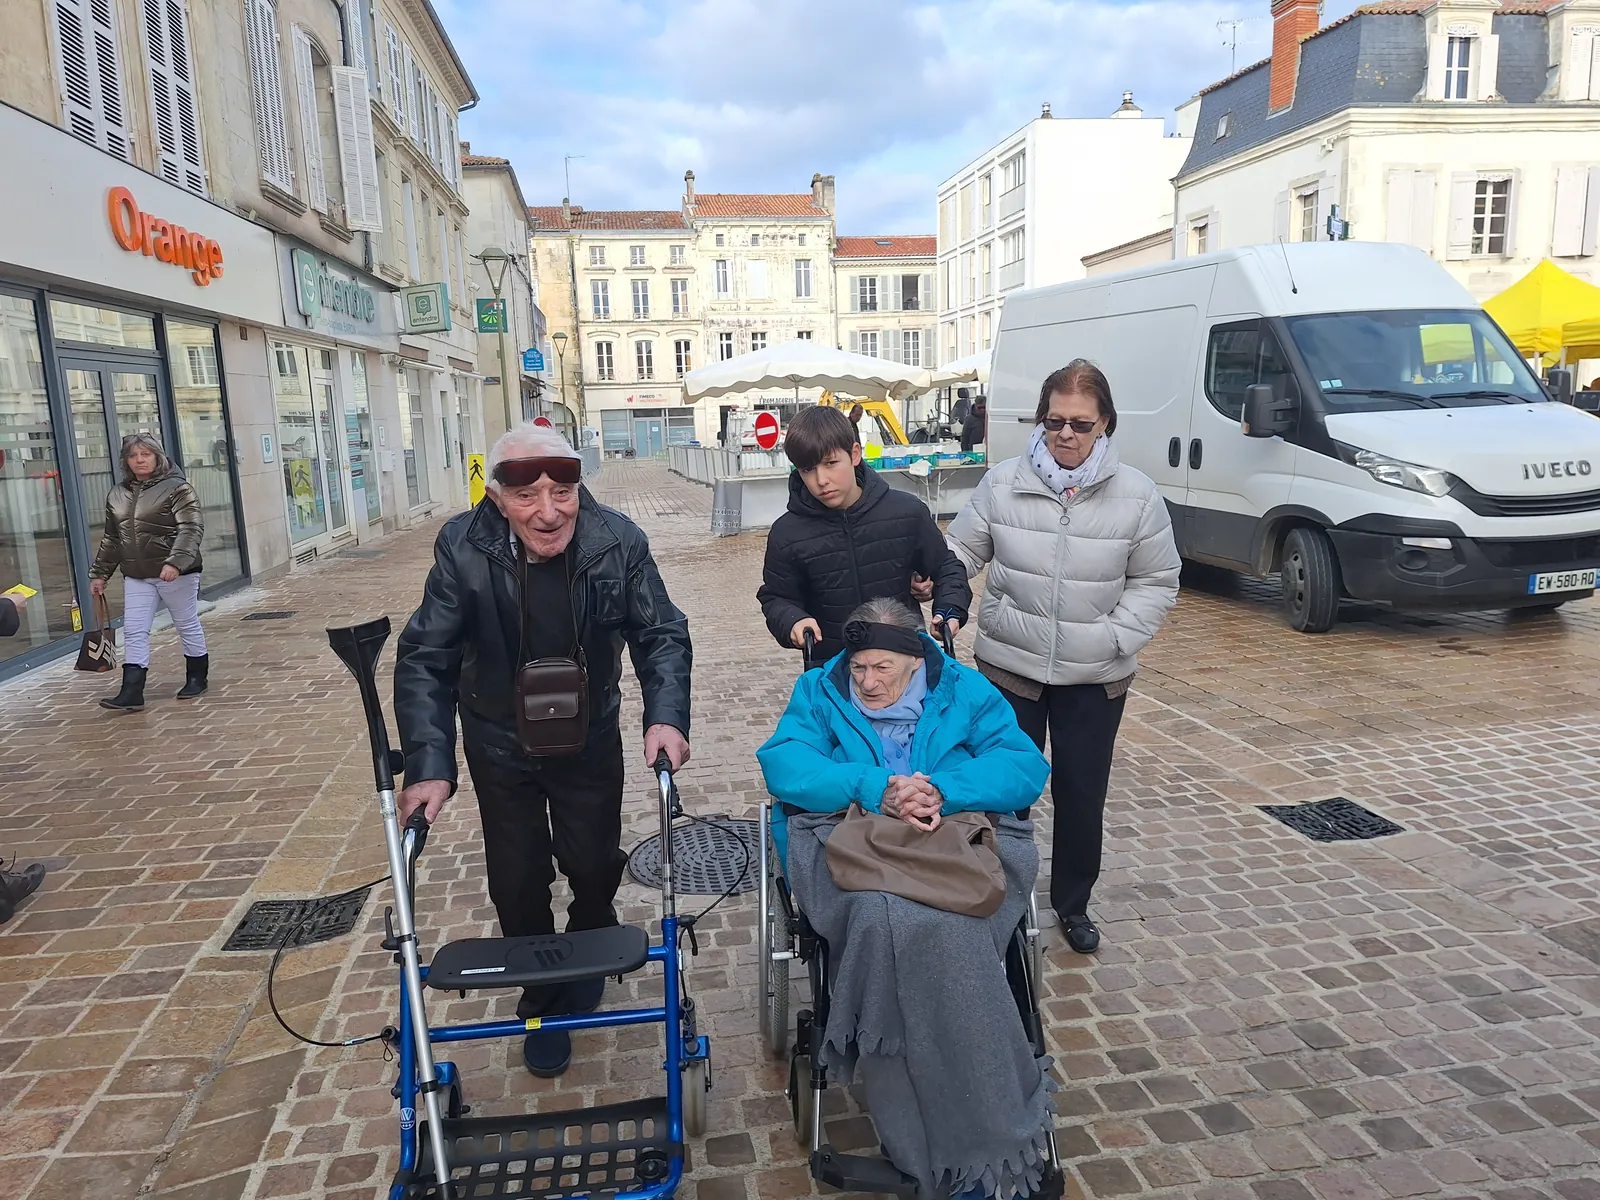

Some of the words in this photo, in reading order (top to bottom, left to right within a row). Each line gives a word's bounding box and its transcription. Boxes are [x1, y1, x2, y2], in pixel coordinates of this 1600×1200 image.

[108, 186, 224, 286] Orange
[412, 315, 438, 323] entendre
[1522, 460, 1592, 480] IVECO
